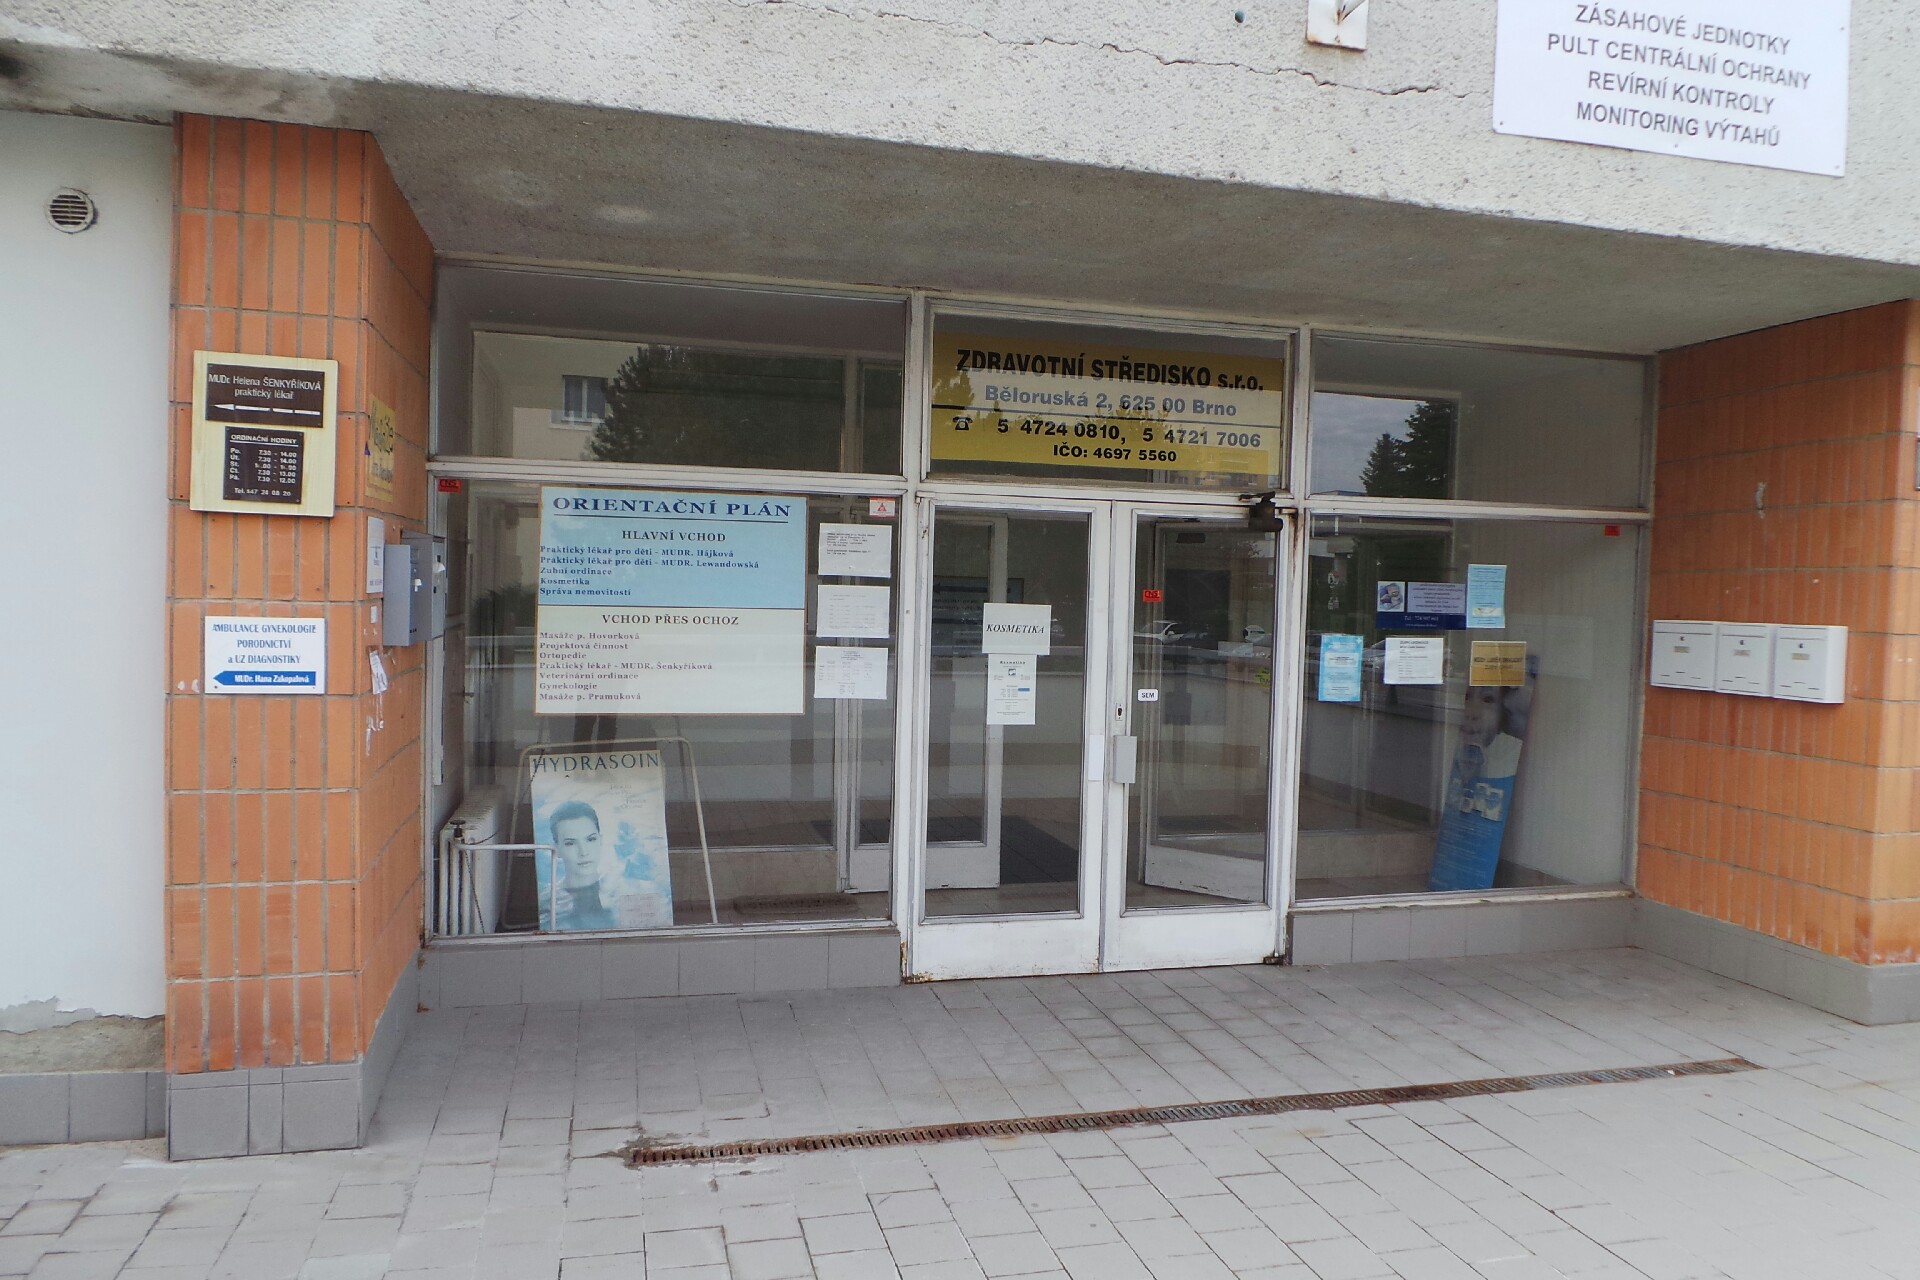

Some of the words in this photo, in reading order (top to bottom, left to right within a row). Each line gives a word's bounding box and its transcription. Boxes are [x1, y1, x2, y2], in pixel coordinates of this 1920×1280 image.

[1576, 3, 1687, 37] ZÁSAHOVÉ
[1692, 22, 1791, 55] JEDNOTKY
[1547, 33, 1599, 57] PULT
[1606, 41, 1717, 75] CENTRÁLNÍ
[1722, 58, 1811, 90] OCHRANY
[1588, 71, 1668, 99] REVÍRNÍ
[1673, 85, 1775, 115] KONTROLY
[1577, 102, 1699, 137] MONITORING
[1705, 119, 1780, 147] VÝTAHŮ
[956, 349, 1084, 380] ZDRAVOTNÍ
[1091, 356, 1211, 387] STŘEDISKO
[1218, 373, 1264, 391] s.r.o.
[233, 376, 260, 386] Helena
[263, 377, 321, 391] ŠENKYŘÍKOVÁ
[235, 388, 271, 399] praktický
[275, 390, 294, 400] lékař
[985, 384, 1089, 408] Běloruská
[1096, 393, 1114, 412] 2,
[1120, 395, 1156, 413] 625
[1162, 397, 1186, 414] 00
[1193, 399, 1238, 417] Brno
[997, 418, 1009, 434] 5
[1020, 419, 1068, 437] 4724
[1074, 423, 1127, 444] 0810,
[1142, 427, 1154, 442] 5
[1164, 429, 1209, 446] 4721
[1217, 432, 1261, 448] 7006
[1053, 441, 1089, 458] IČO:
[1093, 447, 1132, 461] 4697
[1138, 449, 1177, 463] 5560
[553, 497, 718, 516] ORIENTAČNÍ
[727, 502, 791, 517] PLÁN
[622, 529, 675, 541] HLAVNÍ
[679, 532, 726, 543] VCHOD
[540, 546, 585, 555] Praktický
[588, 546, 613, 555] lékař
[615, 548, 632, 557] pro
[635, 547, 653, 555] děti
[661, 549, 694, 557] MUDR.
[697, 549, 734, 558] Hájková
[540, 557, 585, 565] Praktický
[588, 557, 613, 566] lékař
[615, 559, 632, 567] pro
[635, 558, 653, 566] děti
[697, 560, 760, 569] Lewandowská
[540, 567, 568, 575] Zubní
[570, 567, 613, 576] ordinace
[540, 577, 590, 586] Kosmetika
[540, 587, 573, 596] Správa
[575, 588, 632, 596] nemovitostí
[602, 614, 651, 625] VCHOD
[655, 613, 689, 625] PŘES
[693, 616, 740, 625] OCHOZ
[212, 624, 259, 633] AMBULANCE
[261, 624, 317, 634] GYNEKOLOGIE
[986, 623, 1045, 634] KOSMETIKA
[540, 631, 574, 640] Masáže
[589, 632, 640, 640] Hovorková
[237, 639, 292, 649] PORODNICTVÍ
[540, 642, 591, 650] Projektová
[593, 642, 629, 650] činnost
[235, 655, 246, 664] UZ
[248, 655, 301, 664] DIAGNOSTIKY
[540, 652, 587, 660] Ortopedie
[540, 662, 584, 671] Praktický
[587, 662, 612, 670] lékař
[621, 662, 654, 670] MUDR.
[656, 661, 713, 671] Šenkyříková
[234, 675, 254, 683] MUDr.
[255, 675, 272, 683] Hana
[540, 672, 595, 680] Veterinární
[597, 672, 639, 680] ordinace
[540, 682, 598, 691] Gynekologie
[540, 693, 574, 701] Masáže
[589, 693, 641, 701] Pramuková
[533, 753, 659, 773] HYDRASOIN
